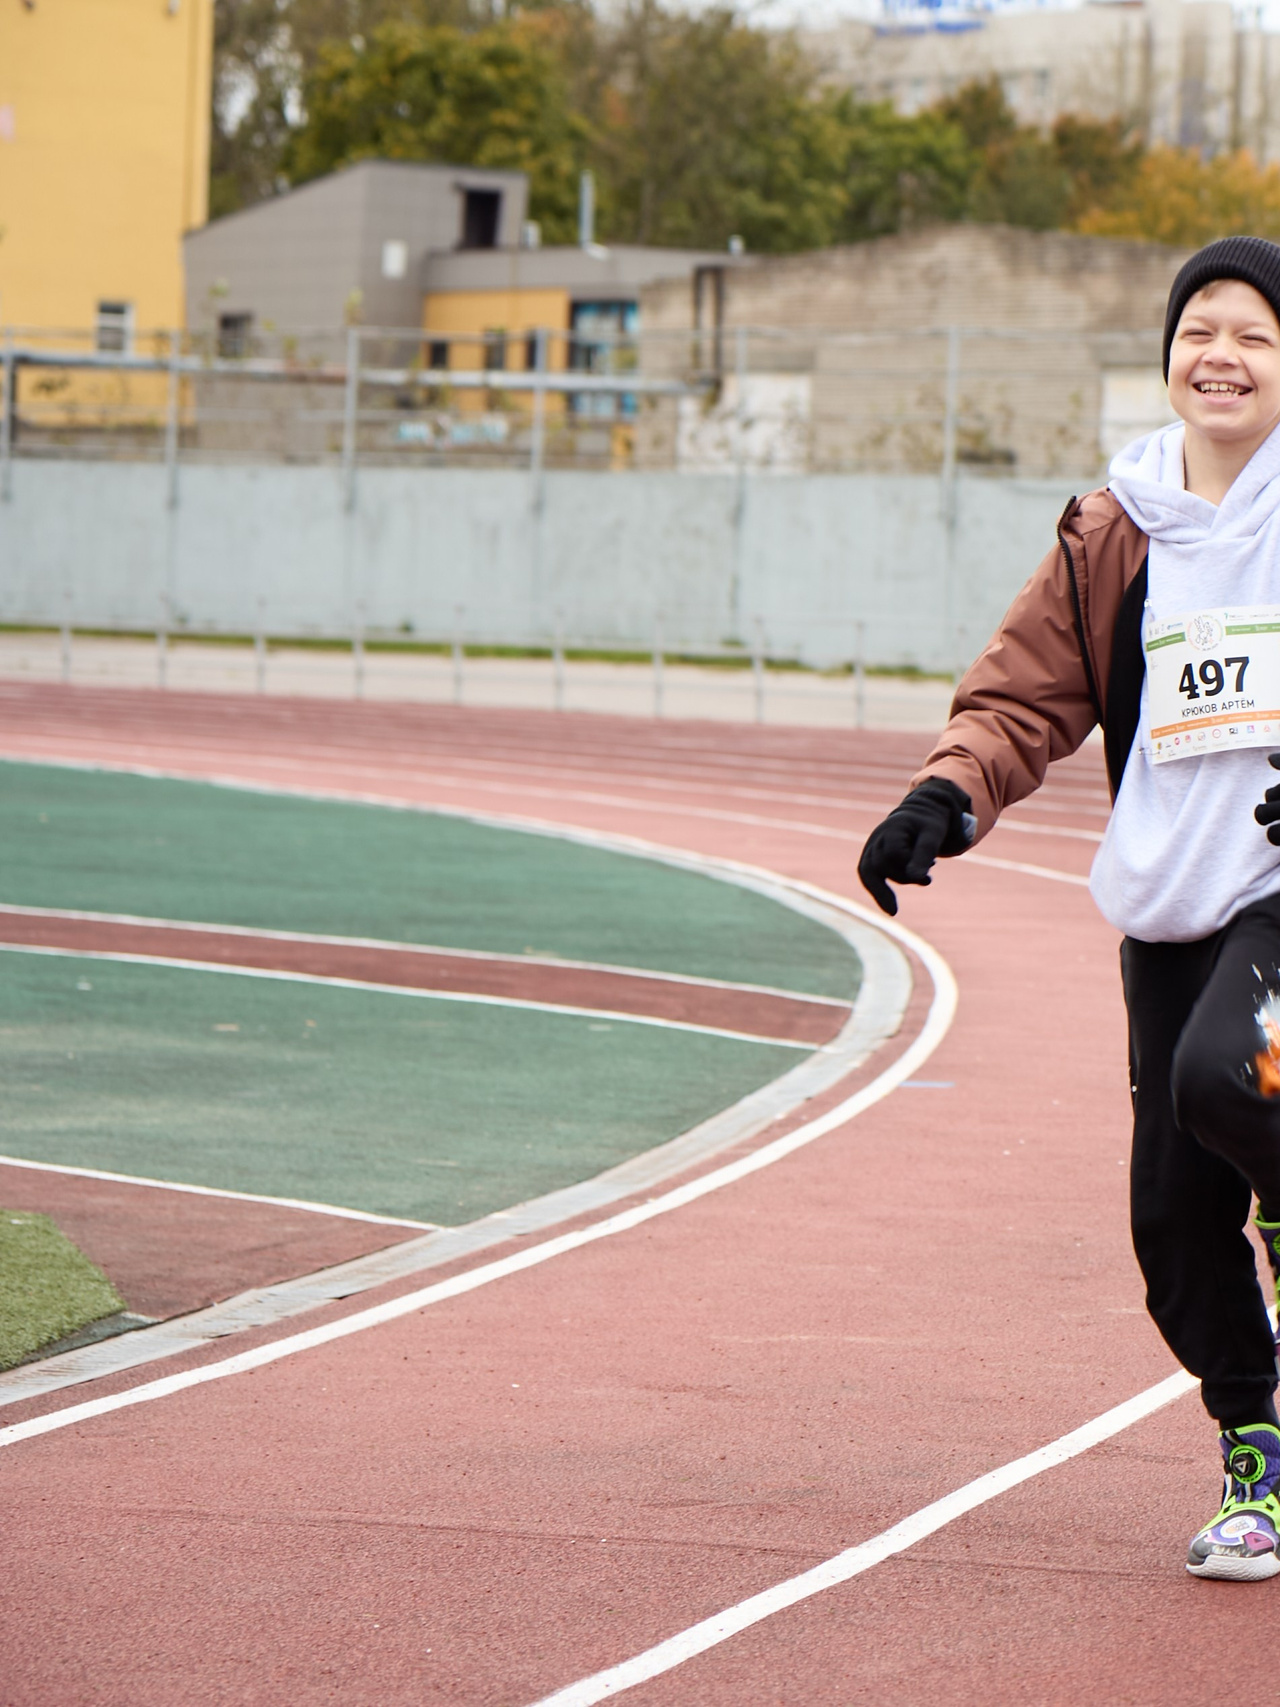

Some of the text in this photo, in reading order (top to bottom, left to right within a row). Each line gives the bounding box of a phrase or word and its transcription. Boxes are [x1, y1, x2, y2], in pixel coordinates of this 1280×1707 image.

[1179, 656, 1250, 700] 497
[1181, 698, 1255, 717] КРЮКОВ АРТЁМ
